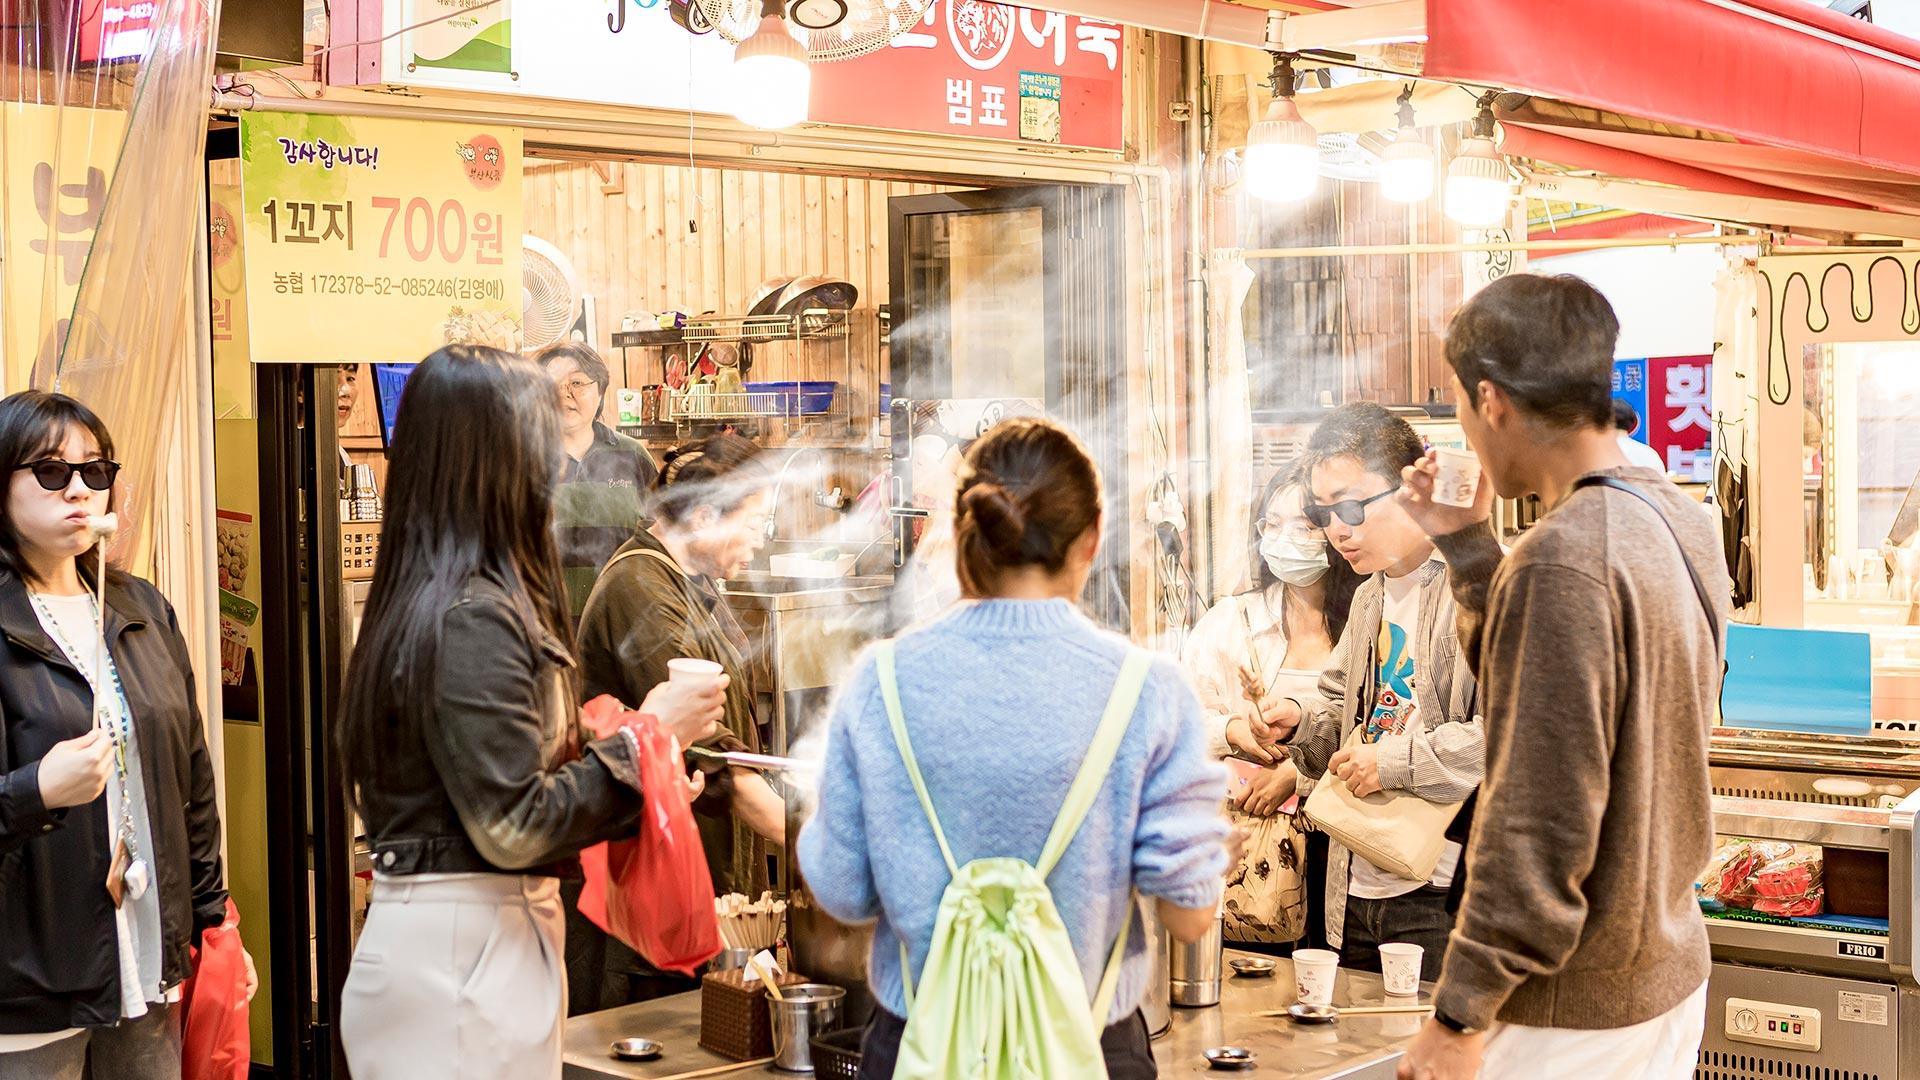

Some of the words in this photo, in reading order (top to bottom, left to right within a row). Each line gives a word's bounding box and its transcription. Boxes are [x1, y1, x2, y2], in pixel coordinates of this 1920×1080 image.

[946, 78, 1008, 127] 범표
[278, 138, 379, 170] 감사합니다!
[263, 199, 353, 250] 1꼬지
[371, 196, 503, 265] 700원
[273, 271, 303, 294] 농협
[311, 275, 504, 301] 172378-52-085246(김영애)
[1846, 943, 1877, 957] FRIO
